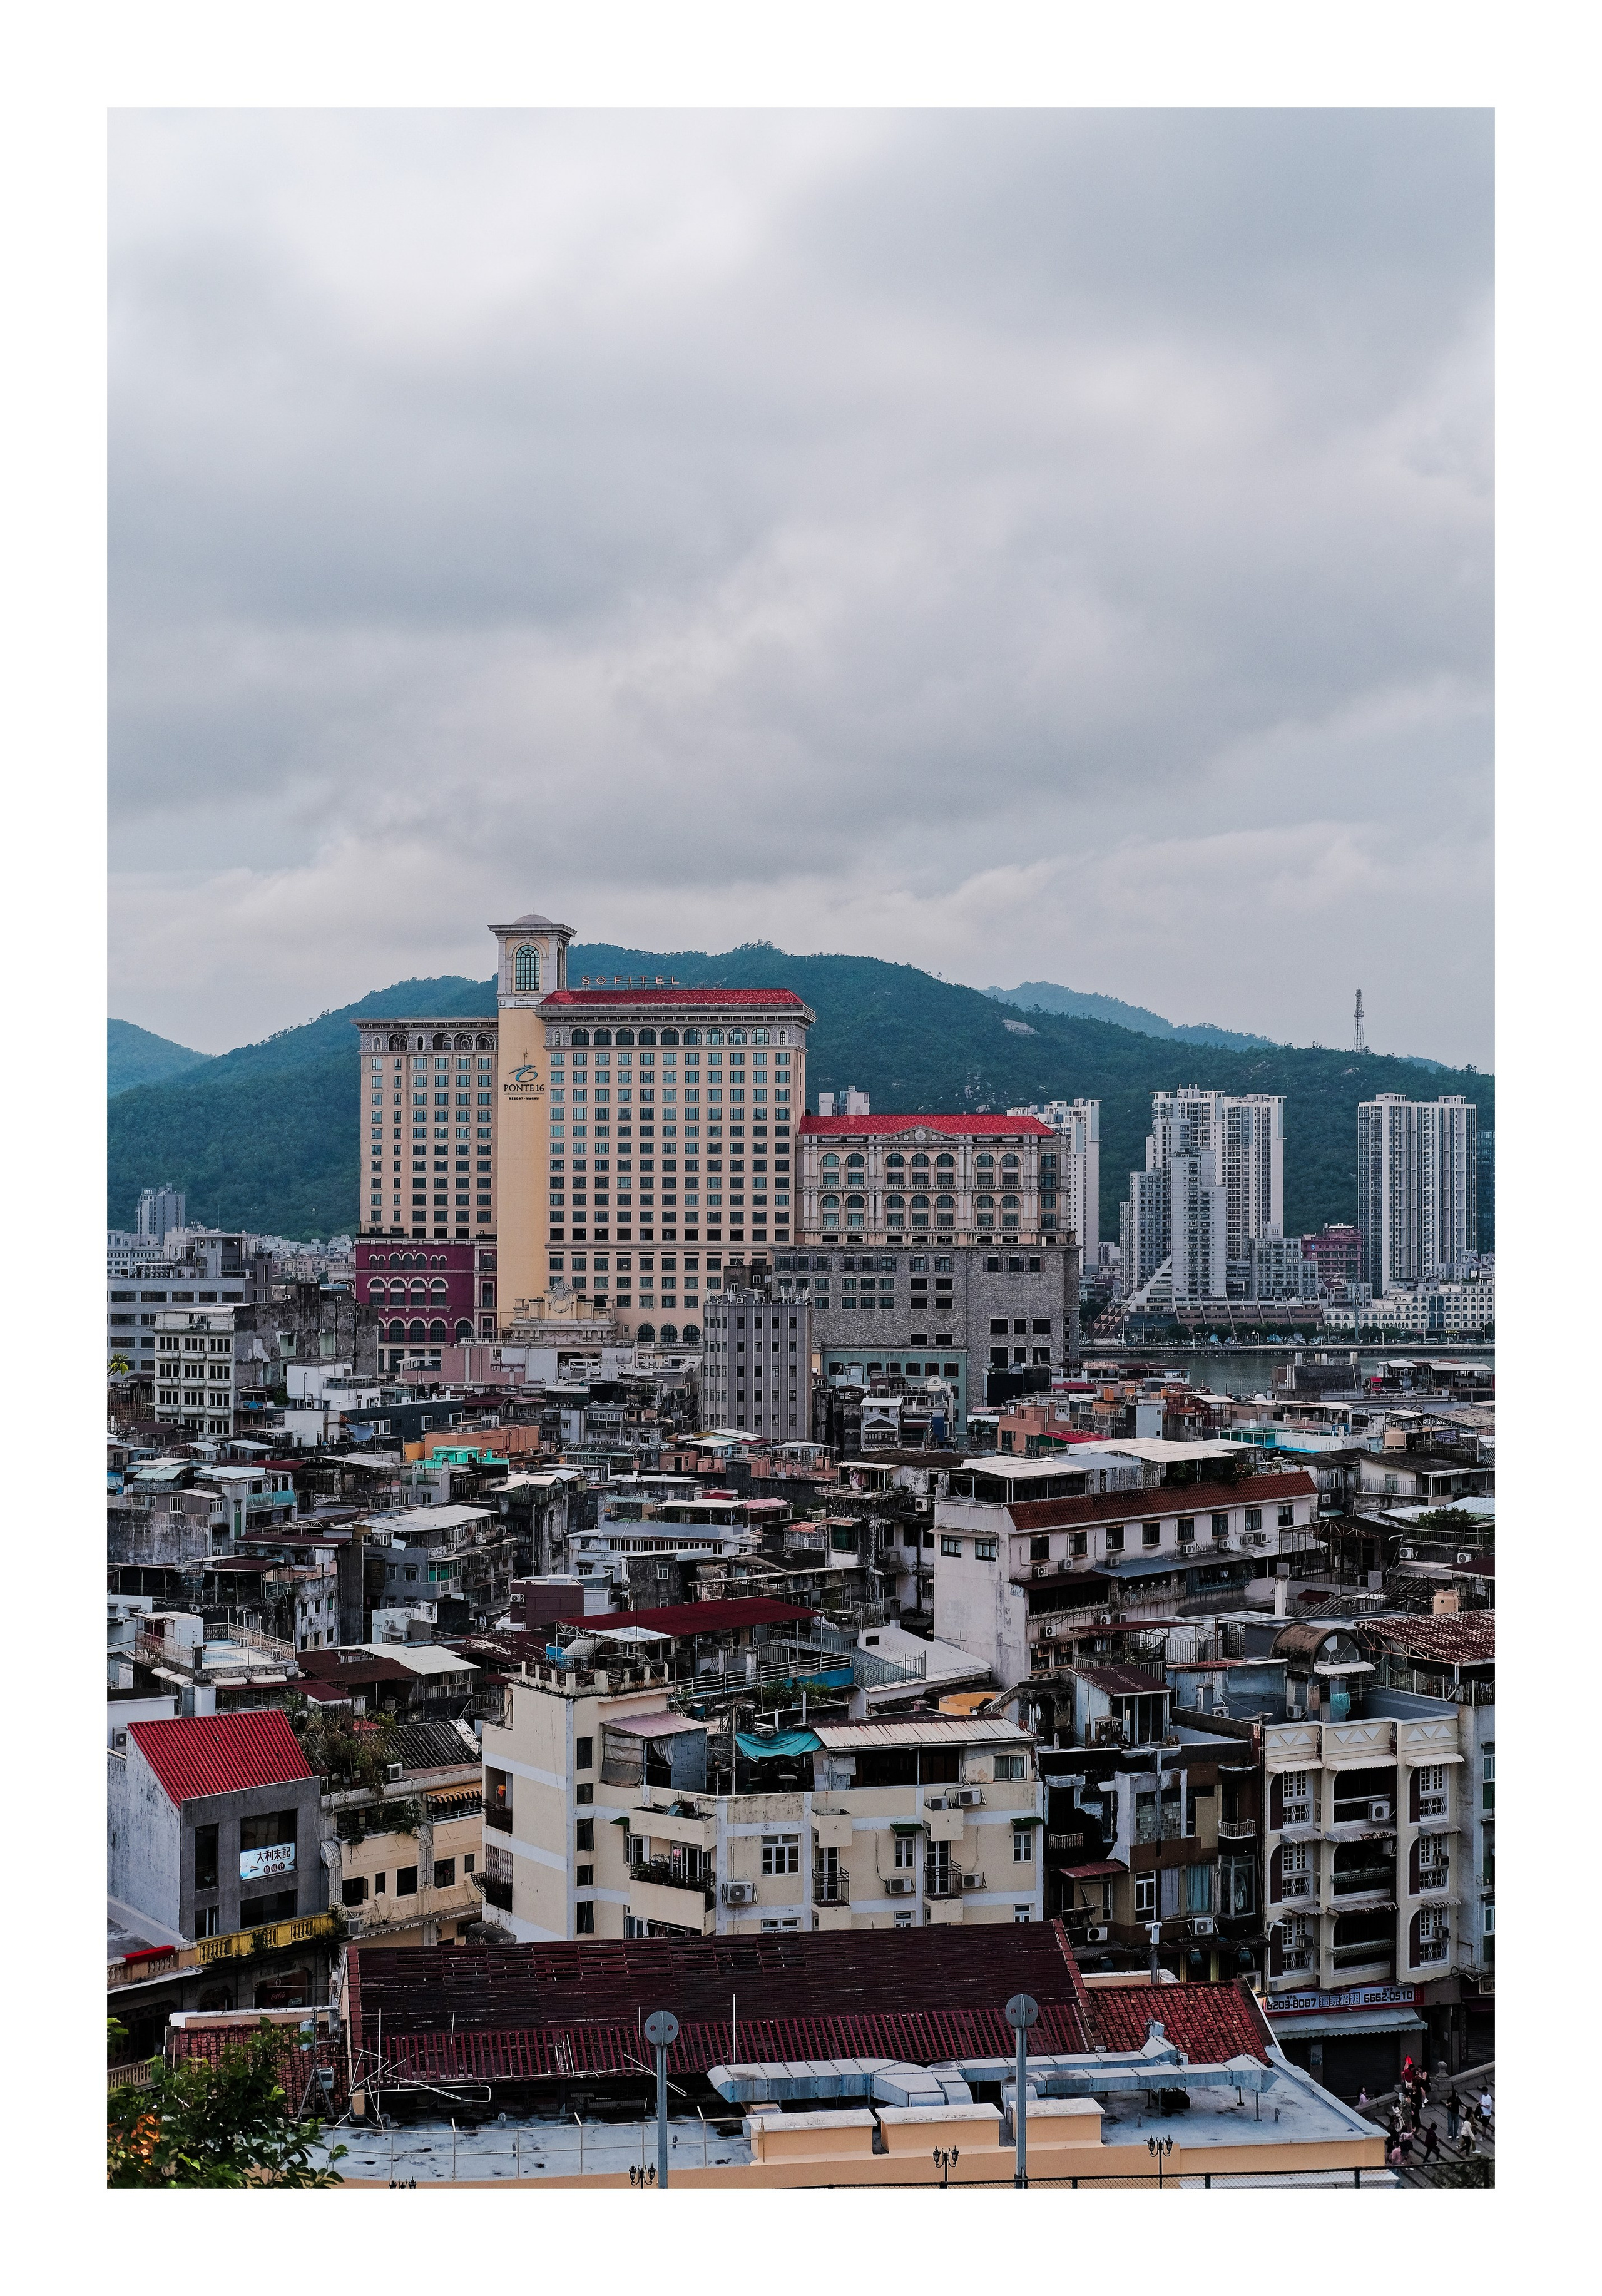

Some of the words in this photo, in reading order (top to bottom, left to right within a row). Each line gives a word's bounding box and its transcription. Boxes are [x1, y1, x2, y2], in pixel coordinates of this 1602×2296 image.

[582, 976, 680, 985] SOFITEL
[1319, 1992, 1361, 2008] 獨家招租
[1364, 1990, 1413, 2003] 6662-0510
[1267, 1998, 1317, 2011] 6203-8087
